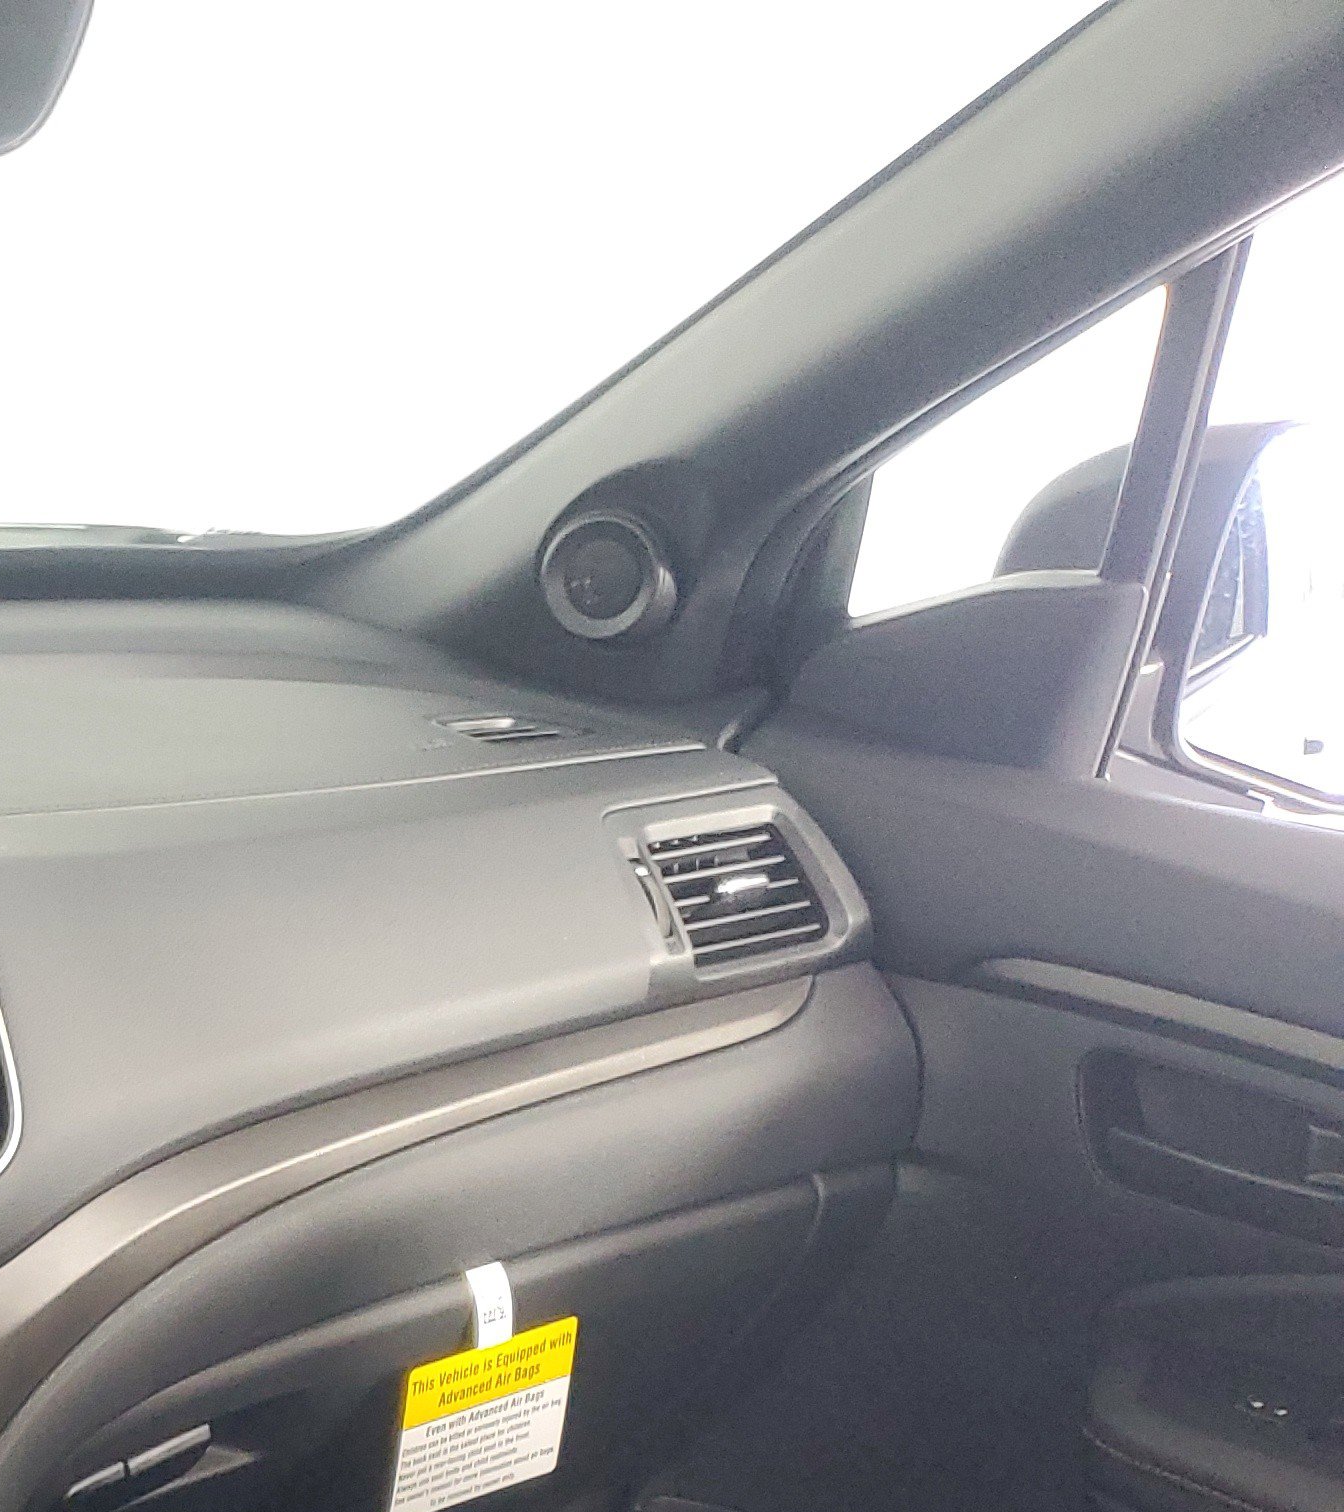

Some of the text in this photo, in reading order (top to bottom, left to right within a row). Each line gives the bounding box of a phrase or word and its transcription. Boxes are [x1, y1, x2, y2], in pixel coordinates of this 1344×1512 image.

[412, 1331, 572, 1396] This Vehicle is Equipped with
[438, 1362, 541, 1407] Advanced Air Bags
[469, 1400, 508, 1422] Advanced
[511, 1397, 523, 1408] Air
